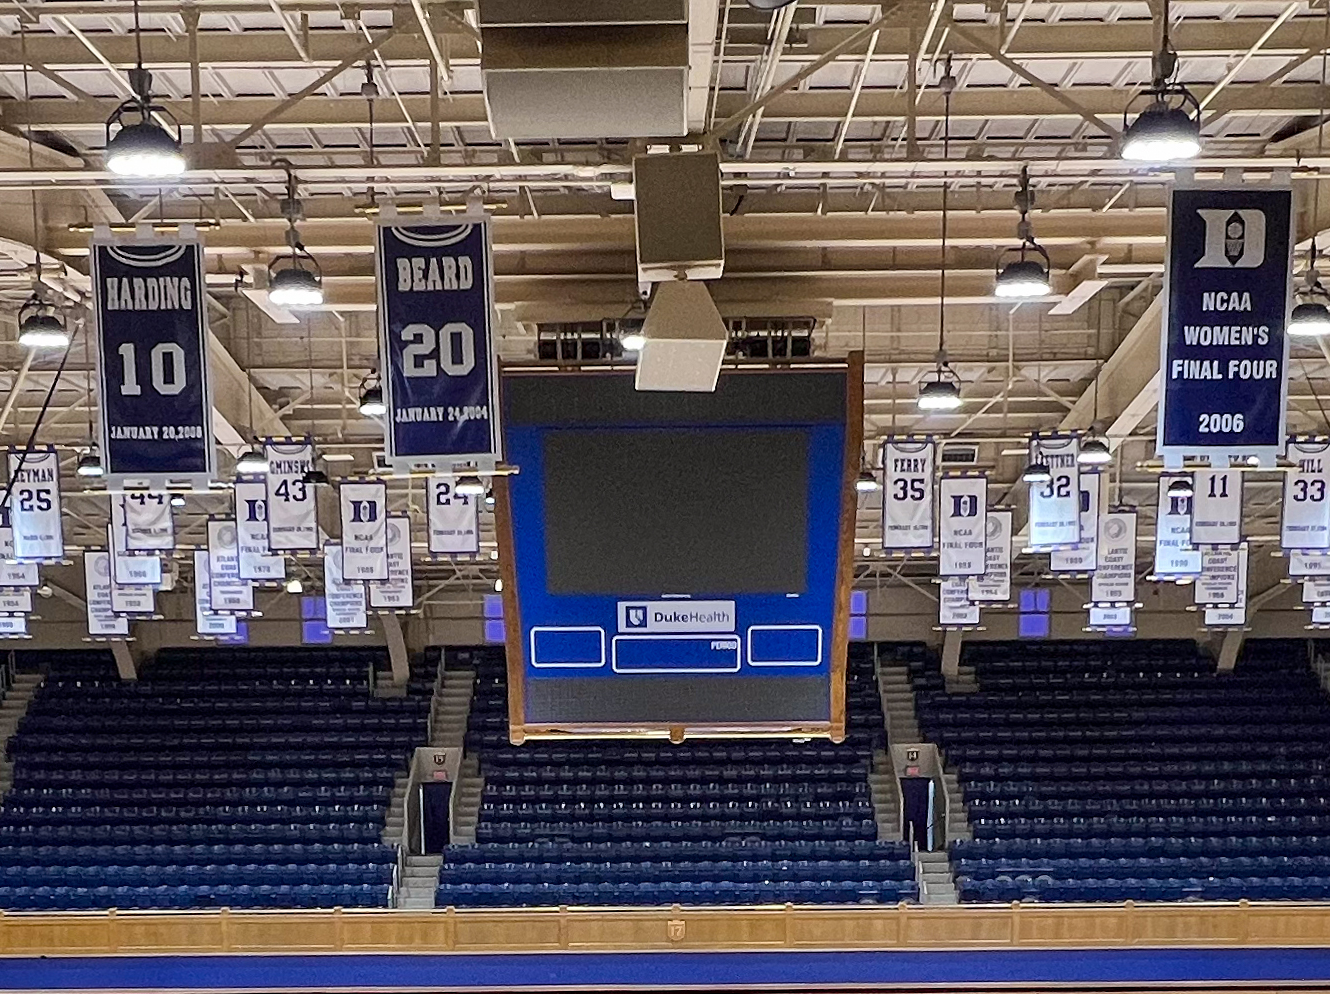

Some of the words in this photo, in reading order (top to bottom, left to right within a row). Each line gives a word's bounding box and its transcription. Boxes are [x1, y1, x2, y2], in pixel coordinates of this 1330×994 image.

[396, 256, 474, 292] BEARD
[106, 277, 192, 310] HARDING
[1202, 292, 1252, 311] NCAA
[1184, 325, 1269, 346] WOMEN'S
[400, 322, 476, 378] 20
[118, 342, 186, 396] 10
[1171, 360, 1222, 379] FINAL
[1228, 360, 1277, 379] FOUR
[395, 407, 443, 423] JANUARY
[1198, 413, 1244, 433] 2006
[111, 426, 159, 439] JANUARY
[893, 458, 927, 473] FERRY
[274, 479, 308, 503] 43
[893, 477, 926, 501] 35
[1208, 474, 1229, 498] 11
[1292, 479, 1326, 502] 33
[19, 488, 53, 512] 25
